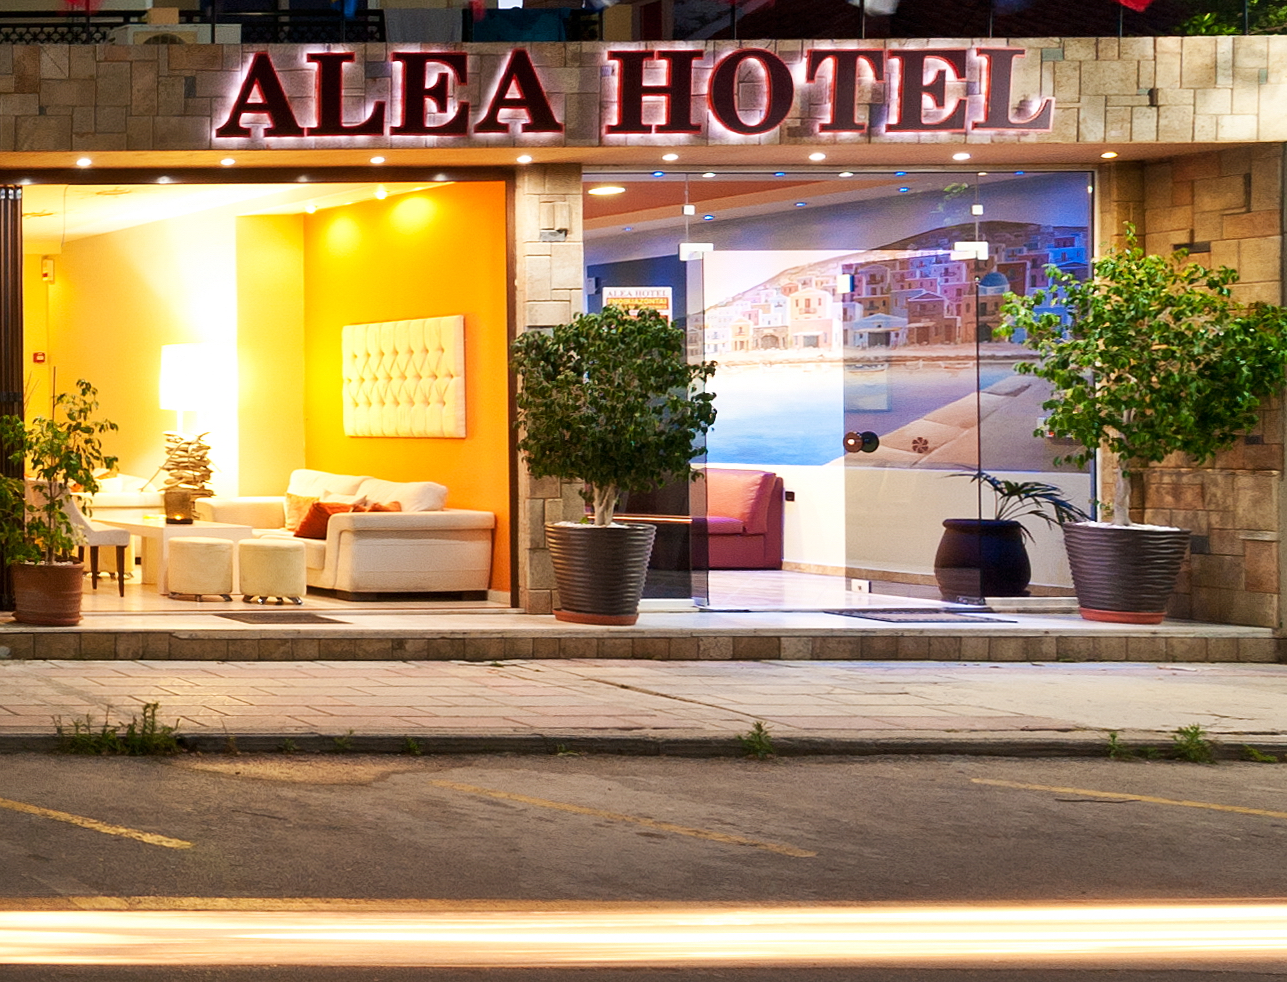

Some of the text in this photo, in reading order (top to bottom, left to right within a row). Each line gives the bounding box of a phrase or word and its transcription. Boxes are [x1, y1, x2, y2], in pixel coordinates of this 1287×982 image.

[215, 47, 1055, 137] ALEA HOTEL
[608, 289, 668, 297] ALEA HOTEL
